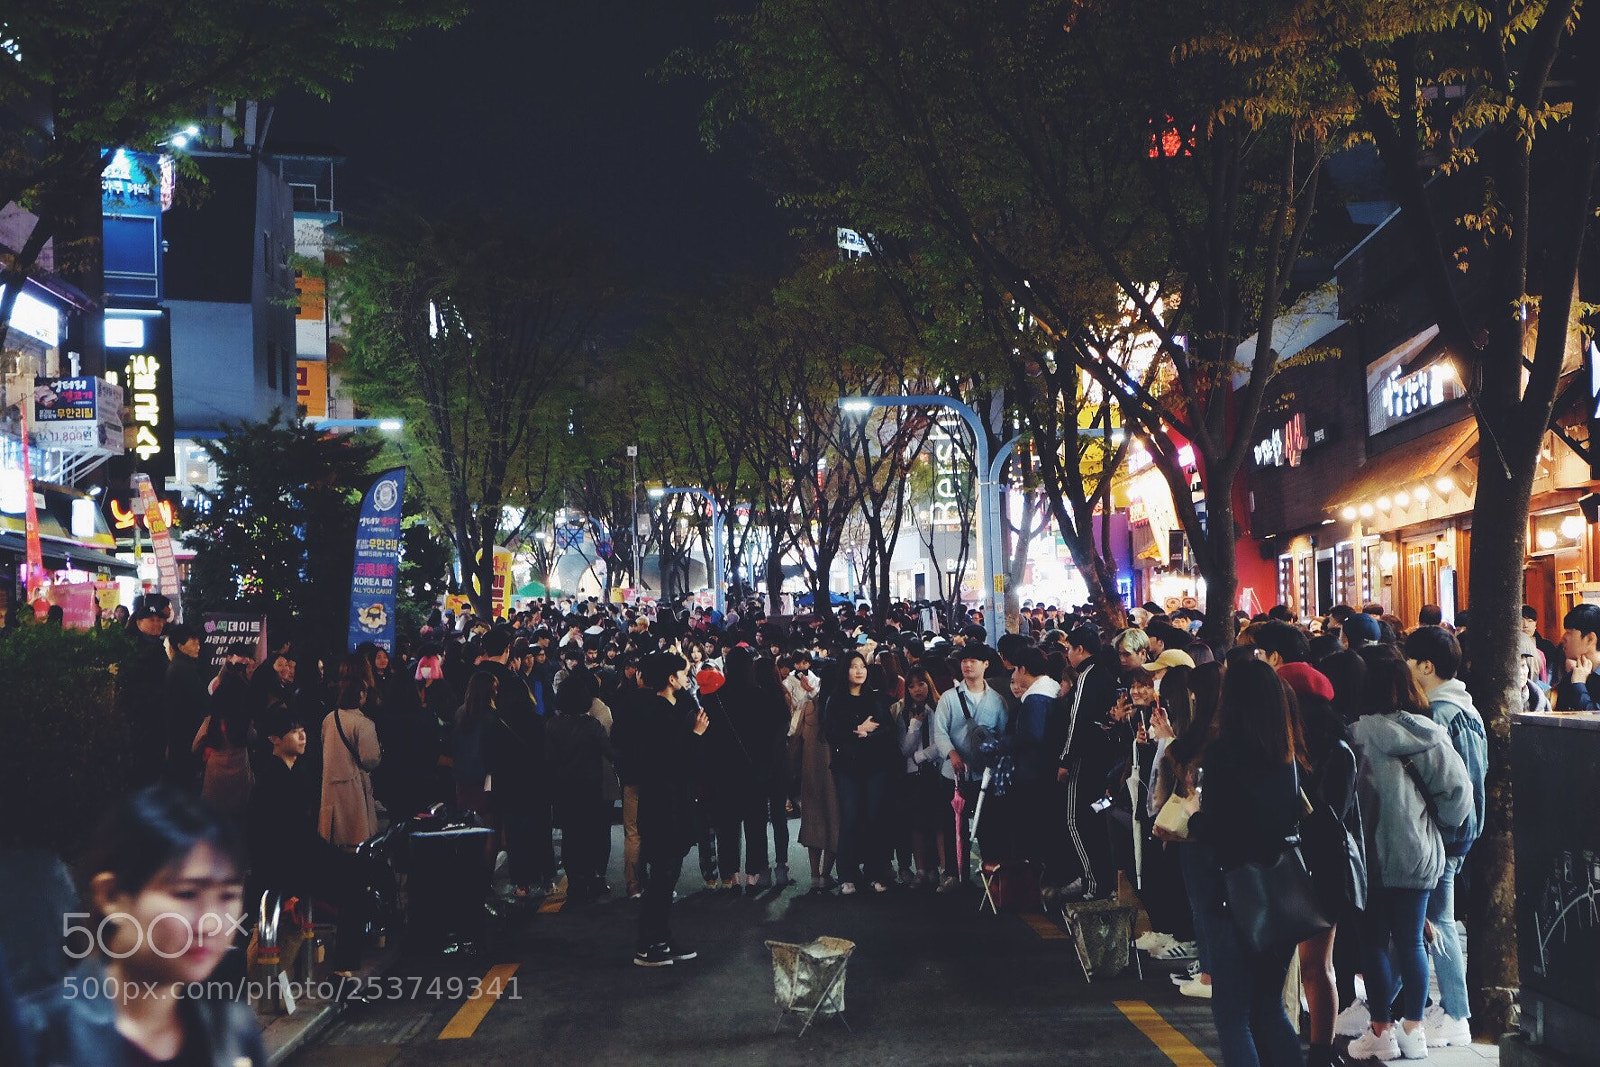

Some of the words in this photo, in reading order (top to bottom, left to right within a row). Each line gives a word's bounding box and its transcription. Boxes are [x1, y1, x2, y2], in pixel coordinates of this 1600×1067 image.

[57, 407, 93, 418] 무한리필
[130, 355, 161, 461] 쌀국수
[354, 577, 380, 586] KOREA
